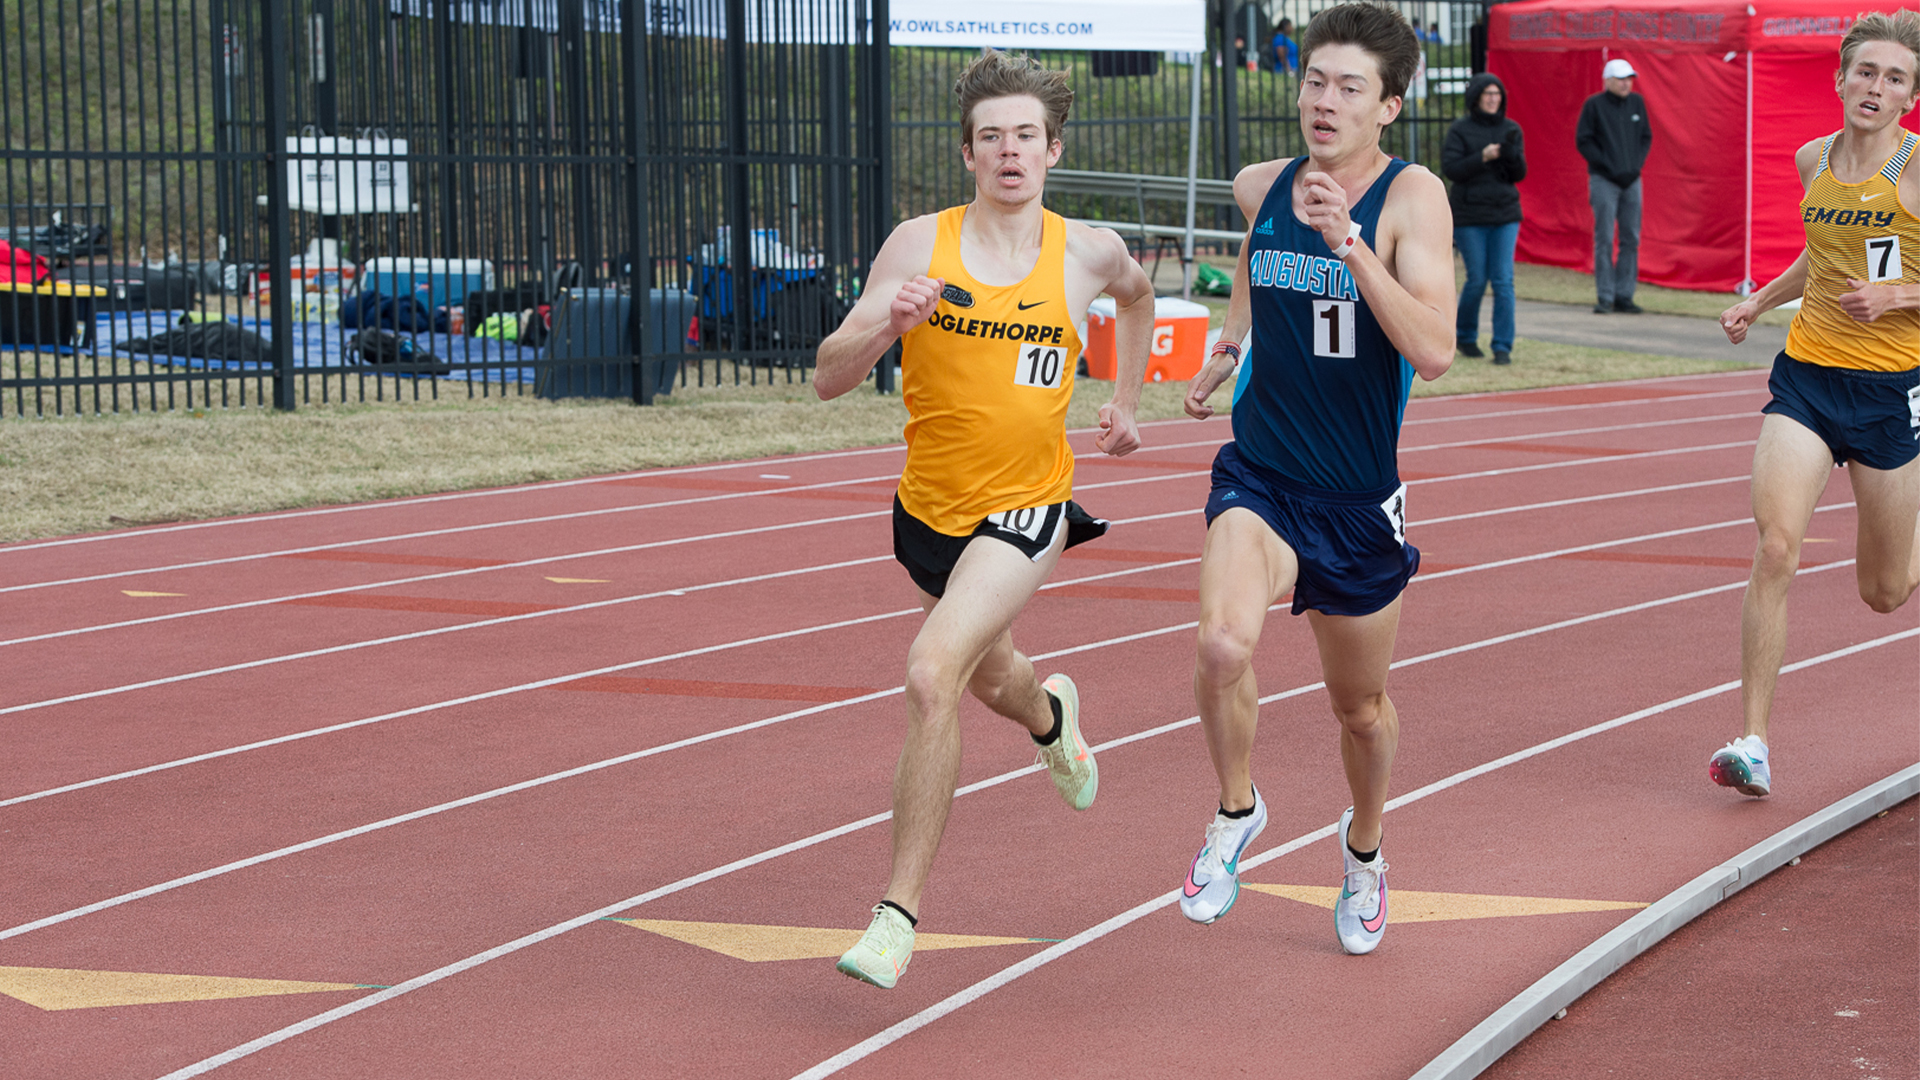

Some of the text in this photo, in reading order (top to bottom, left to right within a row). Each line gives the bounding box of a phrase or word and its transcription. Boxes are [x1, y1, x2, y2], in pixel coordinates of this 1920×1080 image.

[858, 18, 1094, 36] W.OWLSATHLETICS.COM
[1618, 11, 1660, 41] CROSS
[1803, 206, 1896, 228] EMORY
[1250, 249, 1359, 302] AUGUSTA
[1869, 239, 1895, 279] 7
[928, 310, 1064, 345] OGLETHORPE
[1151, 324, 1175, 357] G
[1320, 304, 1340, 354] 1
[1027, 347, 1060, 387] 10
